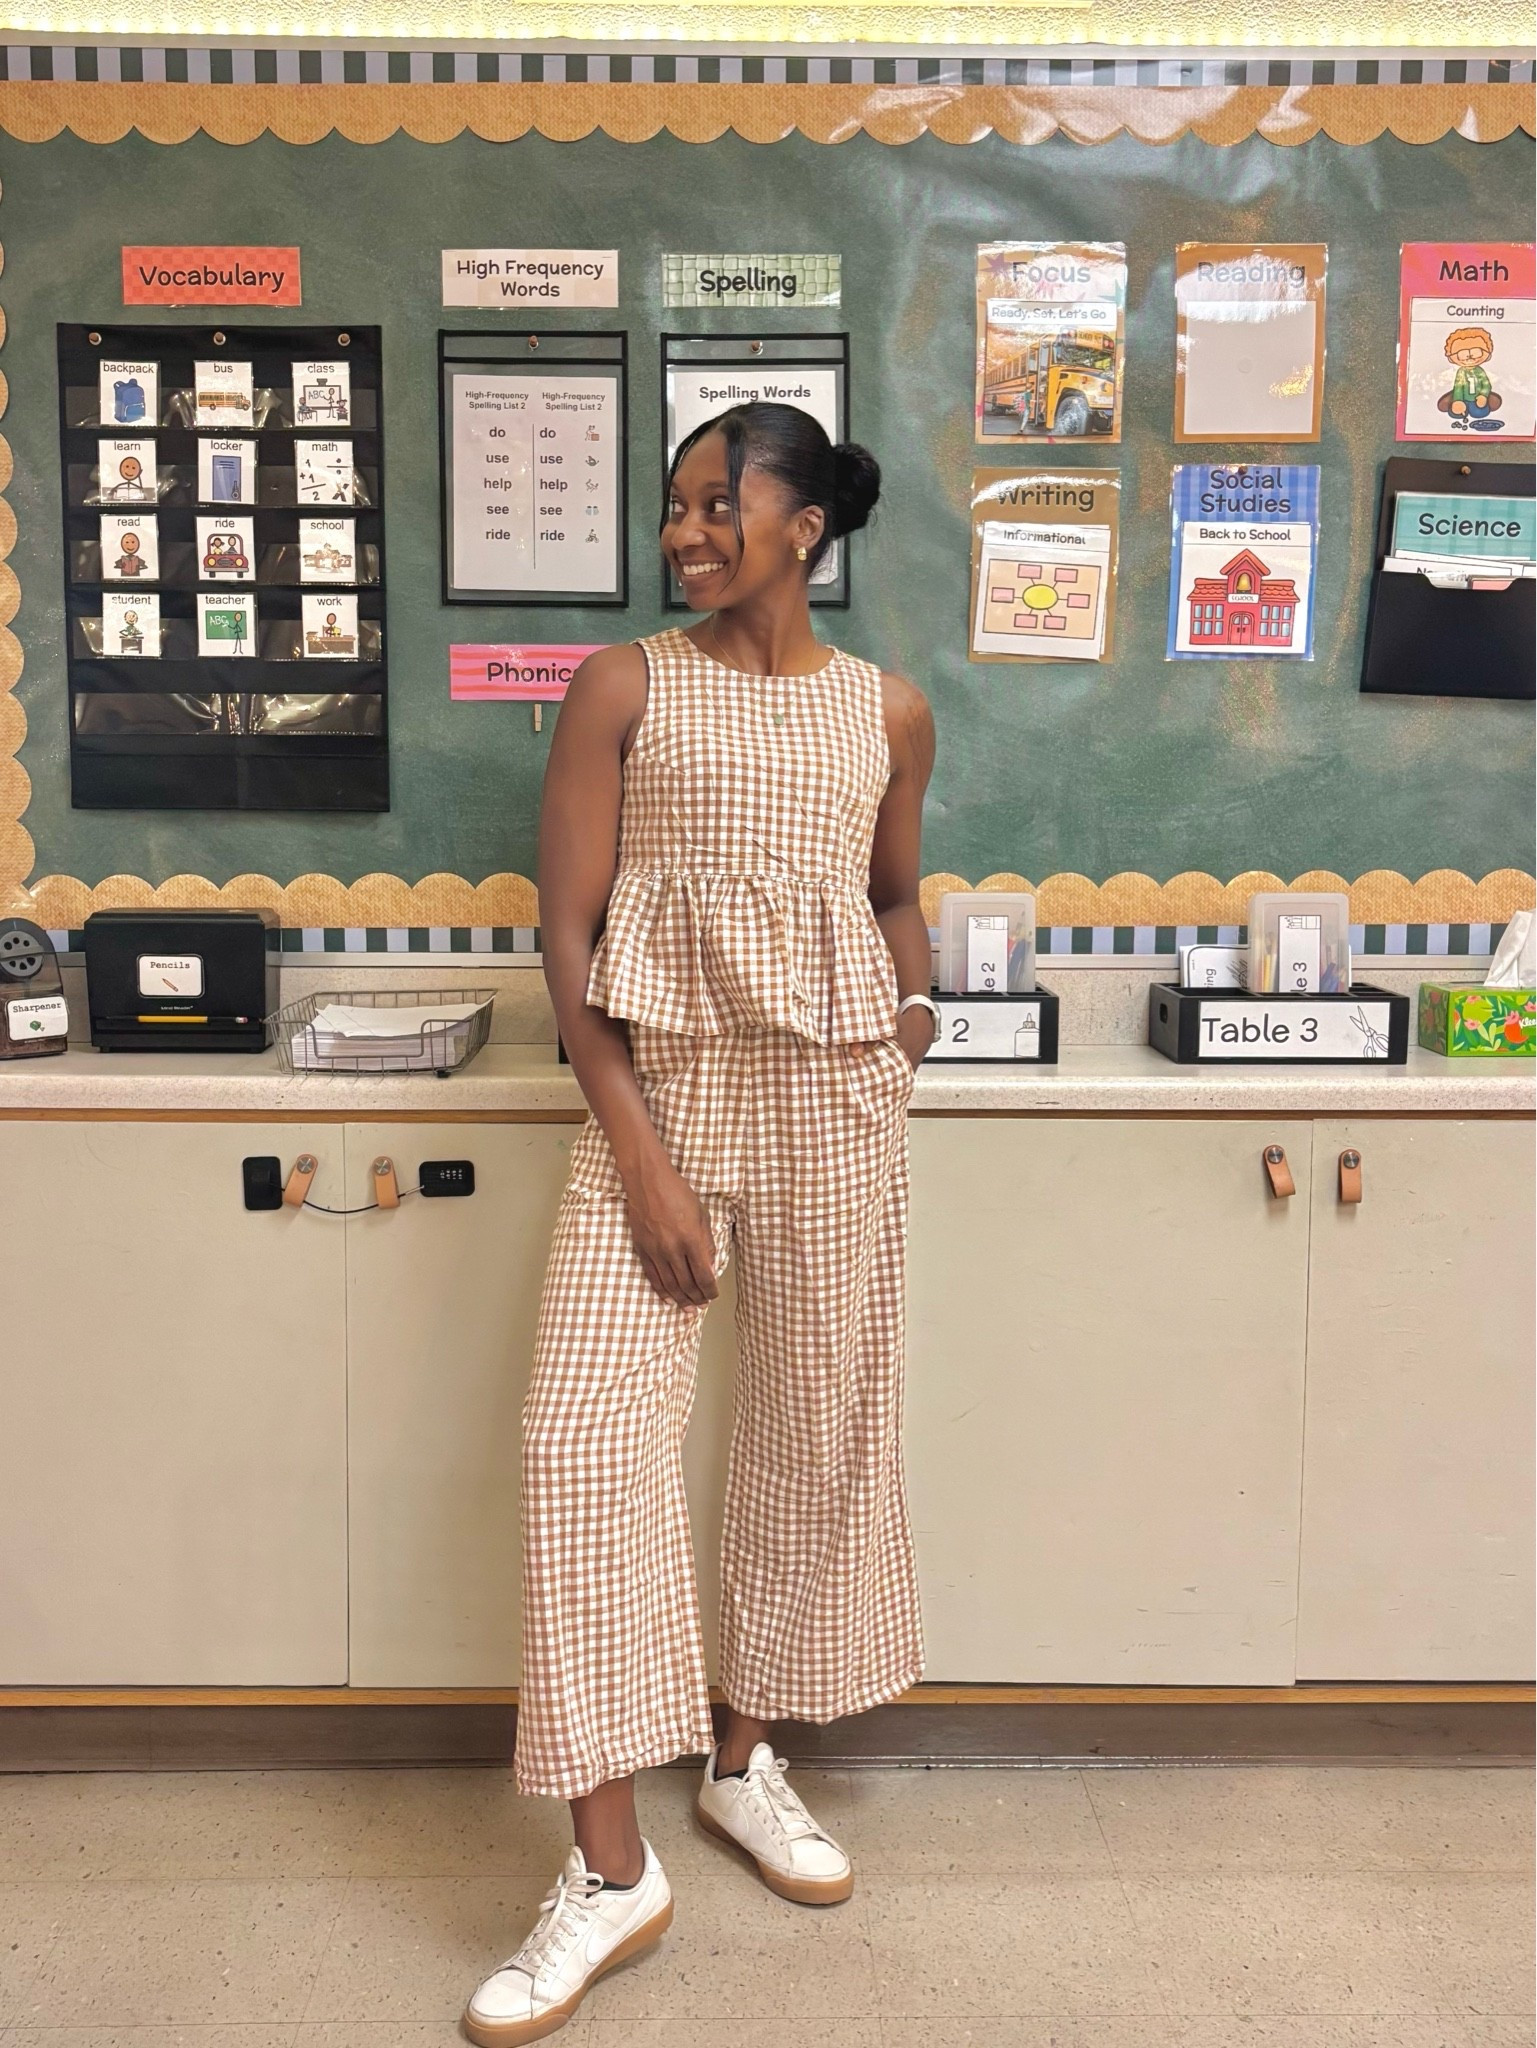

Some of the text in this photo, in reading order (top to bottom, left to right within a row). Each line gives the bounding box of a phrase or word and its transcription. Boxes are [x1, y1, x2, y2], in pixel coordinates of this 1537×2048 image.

[457, 260, 604, 280] High Frequency
[1012, 261, 1091, 283] Focus
[1197, 261, 1306, 288] Reading
[1439, 260, 1509, 282] Math
[138, 262, 285, 293] Vocabulary
[700, 267, 797, 298] Spelling
[500, 281, 560, 297] Words
[1058, 309, 1087, 319] Let's
[1090, 309, 1107, 319] Go
[1446, 305, 1505, 320] Counting
[103, 362, 154, 376] backpack
[213, 363, 234, 374] bus
[307, 363, 335, 373] class
[465, 391, 529, 401] High-Frequency
[542, 391, 606, 402] High-Frequency
[699, 384, 812, 402] Spelling Words
[469, 401, 526, 411] Spelling List 2
[545, 402, 602, 412] Spelling List 2
[489, 427, 506, 438] do
[539, 427, 556, 439] do
[113, 441, 141, 451] learn
[210, 440, 243, 451] locker
[311, 442, 338, 451] math
[486, 454, 510, 464] use
[540, 455, 563, 465] use
[1210, 467, 1283, 489] Social
[484, 477, 512, 492] help
[540, 478, 568, 492] help
[1201, 493, 1292, 513] Studies
[486, 505, 510, 515] see
[540, 505, 563, 516] see
[117, 517, 141, 528] read
[215, 518, 235, 528] ride
[310, 519, 345, 531] school
[1418, 512, 1521, 538] Science
[485, 529, 511, 540] ride
[540, 529, 565, 541] ride
[1200, 528, 1291, 541] Back to School
[112, 594, 152, 605] student
[205, 595, 246, 605] teacher
[317, 596, 343, 606] work
[487, 662, 575, 683] Phonic
[149, 960, 191, 970] Pencils
[12, 1002, 62, 1013] Sharpener
[951, 1017, 970, 1043] 2
[1201, 1013, 1319, 1043] Table 3
